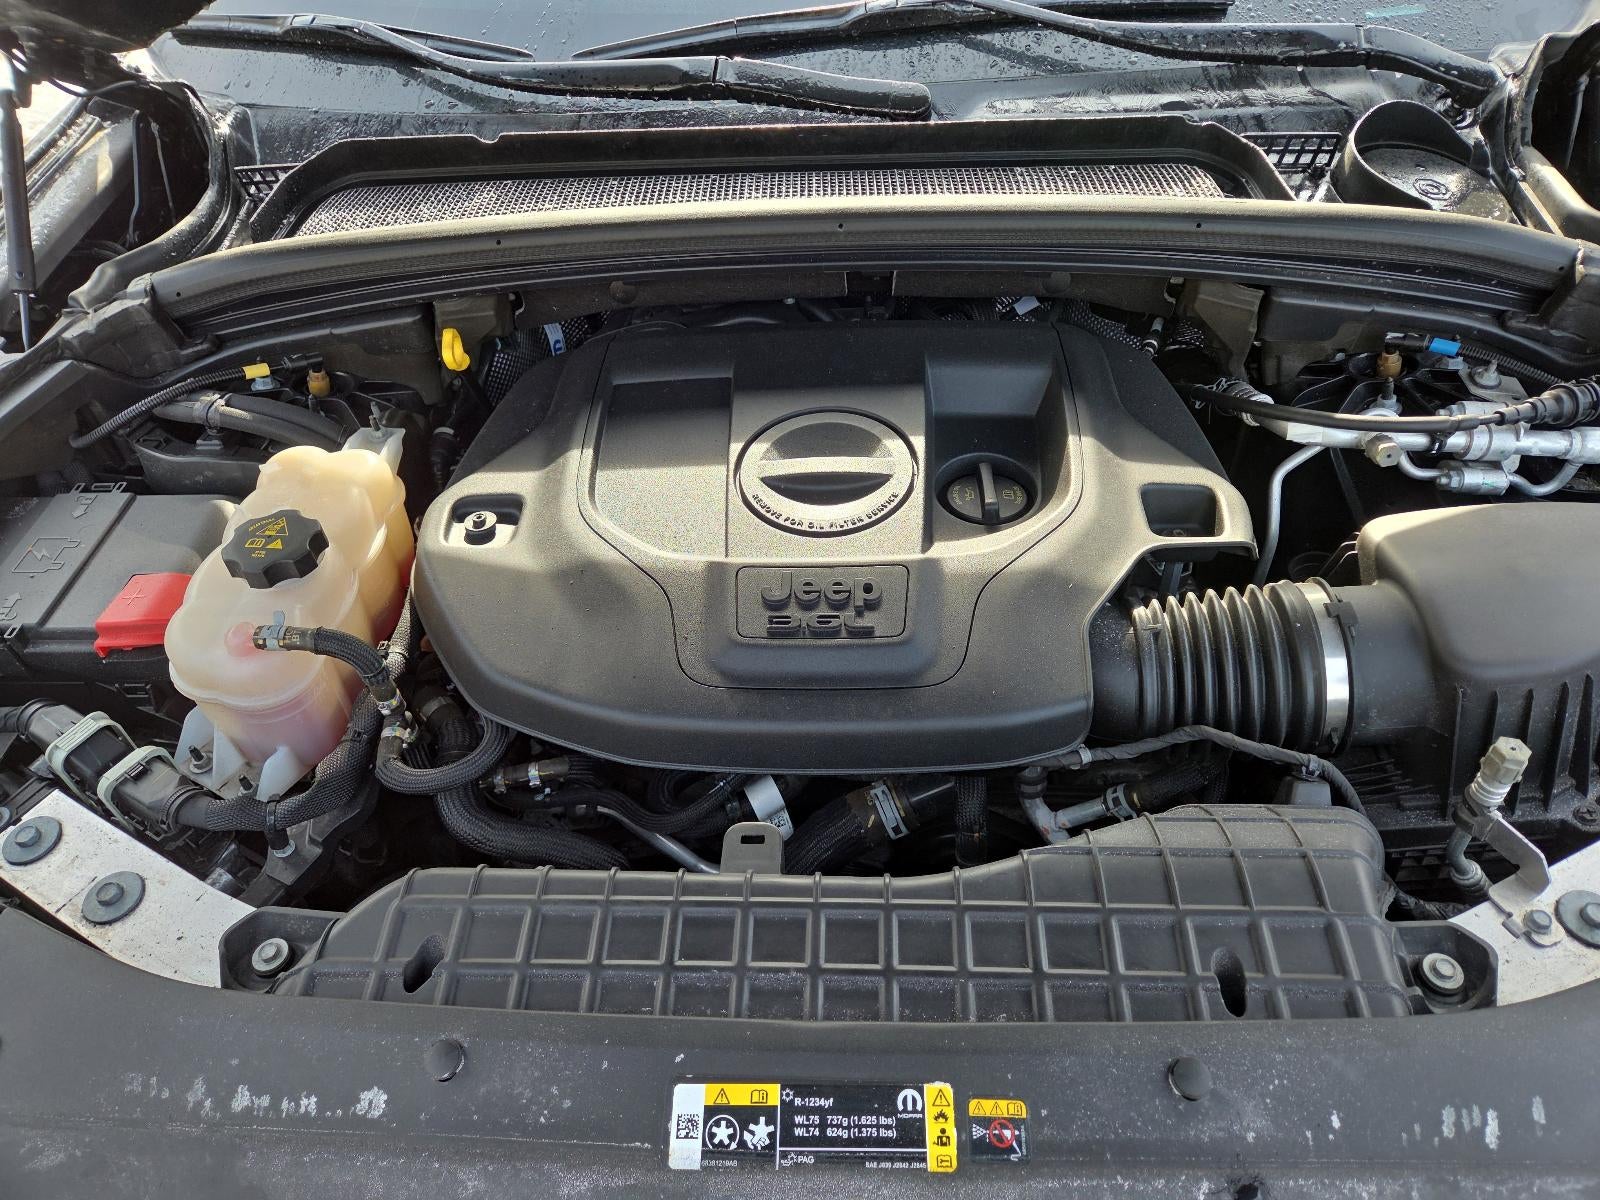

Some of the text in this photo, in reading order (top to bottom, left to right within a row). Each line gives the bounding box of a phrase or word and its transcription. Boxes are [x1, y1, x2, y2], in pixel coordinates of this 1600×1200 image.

[751, 491, 900, 530] REMOVE FOR OIL FILTER SERVICE
[760, 570, 883, 613] Jeep
[794, 1097, 834, 1109] R-1234yf
[794, 1115, 897, 1127] WL75 737g (1.625 lbs)
[794, 1127, 897, 1139] WL74 624g (1.375 lbs)
[797, 1155, 815, 1164] PAG
